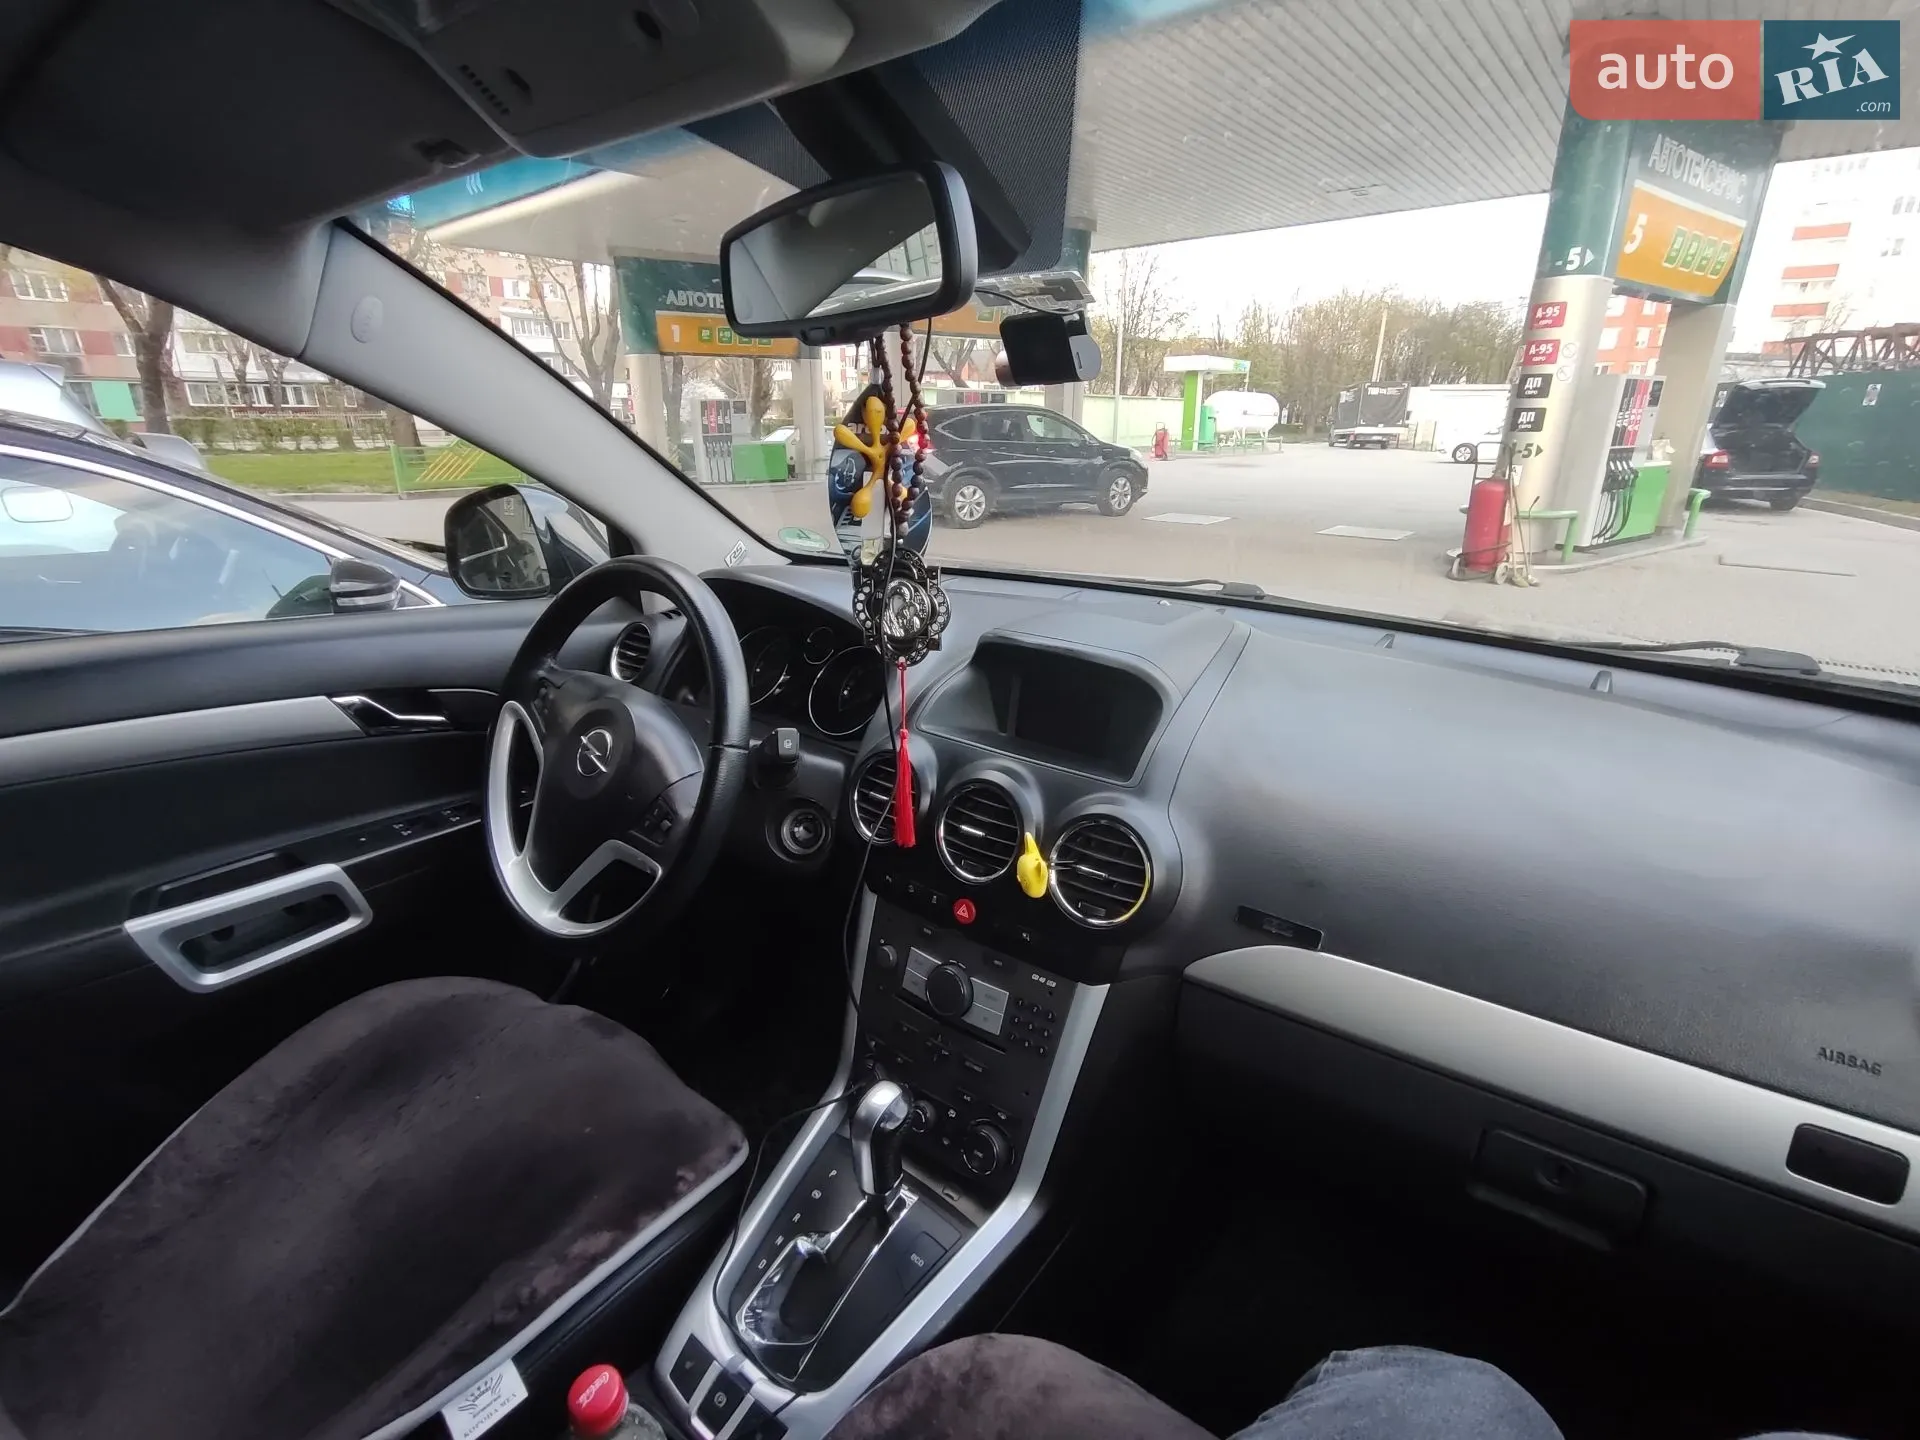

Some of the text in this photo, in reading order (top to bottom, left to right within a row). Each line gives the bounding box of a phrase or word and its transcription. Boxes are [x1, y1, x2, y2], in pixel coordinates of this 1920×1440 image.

[1623, 213, 1648, 254] 5
[671, 324, 681, 343] 1
[1524, 377, 1542, 389] ДП
[1518, 411, 1536, 424] ДП
[1817, 1047, 1882, 1076] AIRBAG
